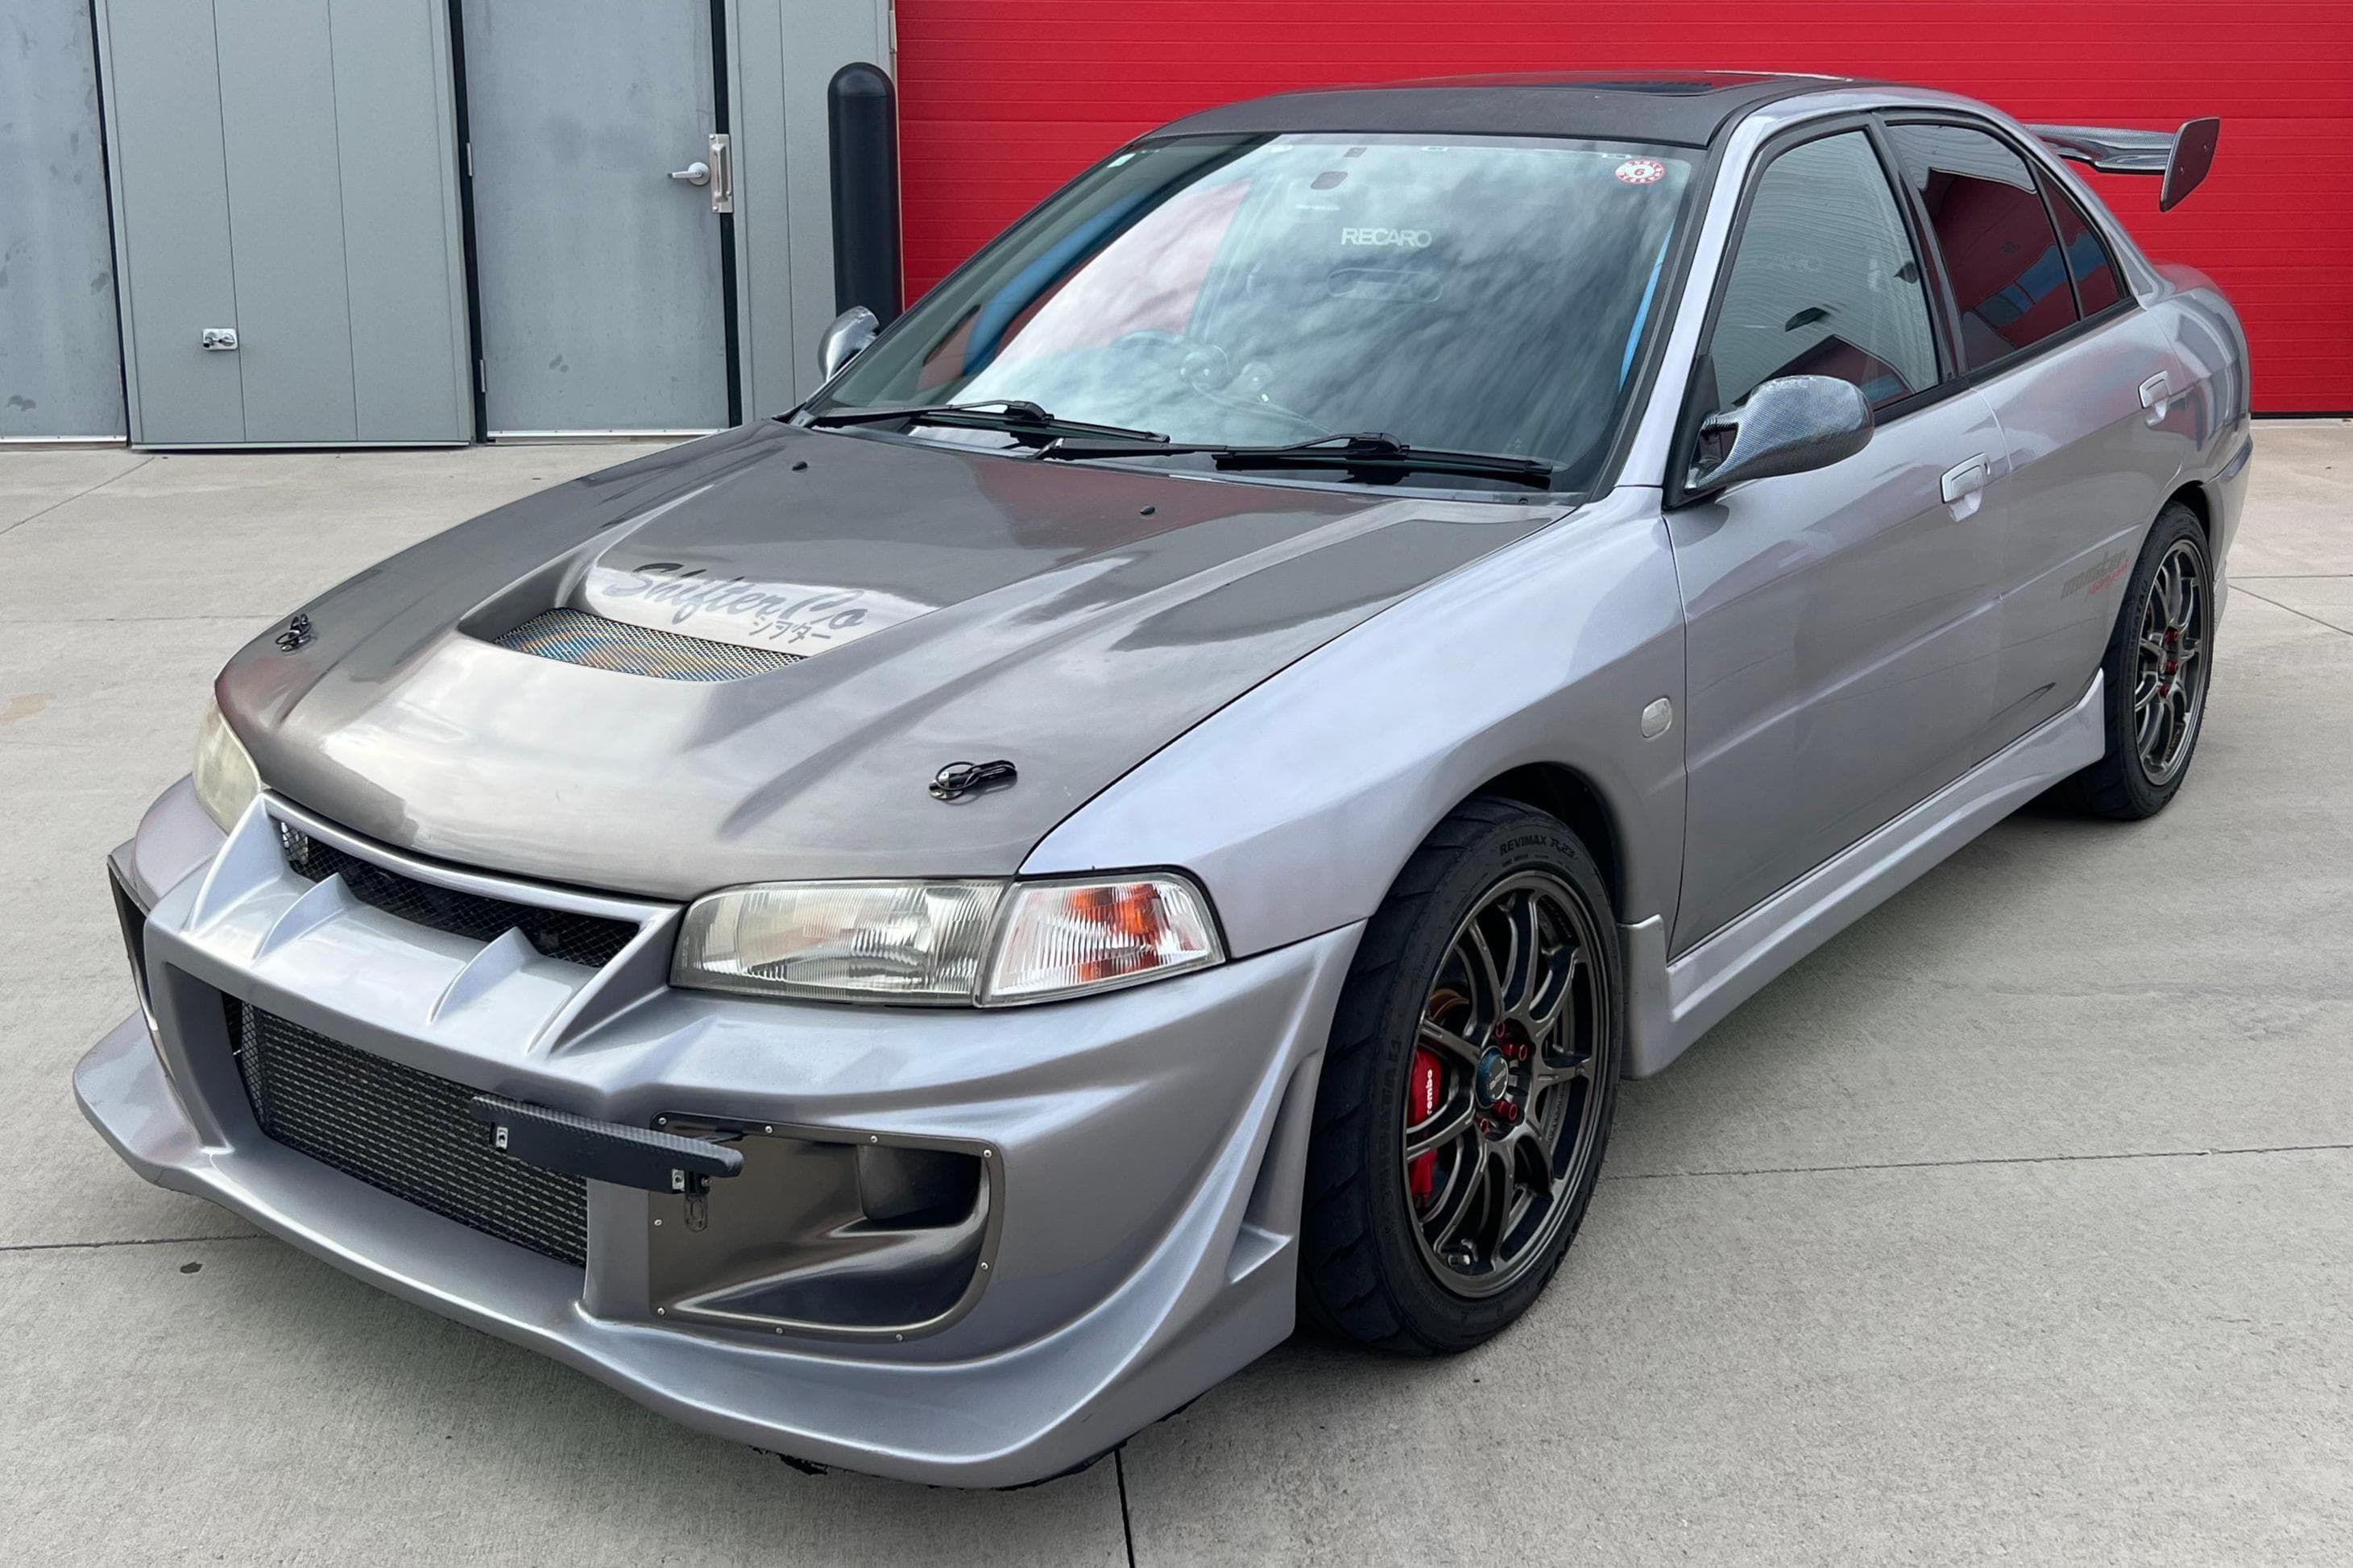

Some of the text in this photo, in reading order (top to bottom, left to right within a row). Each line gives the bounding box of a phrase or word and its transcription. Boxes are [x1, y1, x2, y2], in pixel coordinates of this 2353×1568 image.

[1634, 168, 1646, 176] 6
[1340, 227, 1432, 249] RECARO
[1499, 834, 1547, 856] REVIMAX
[1425, 1069, 1433, 1115] rembo
